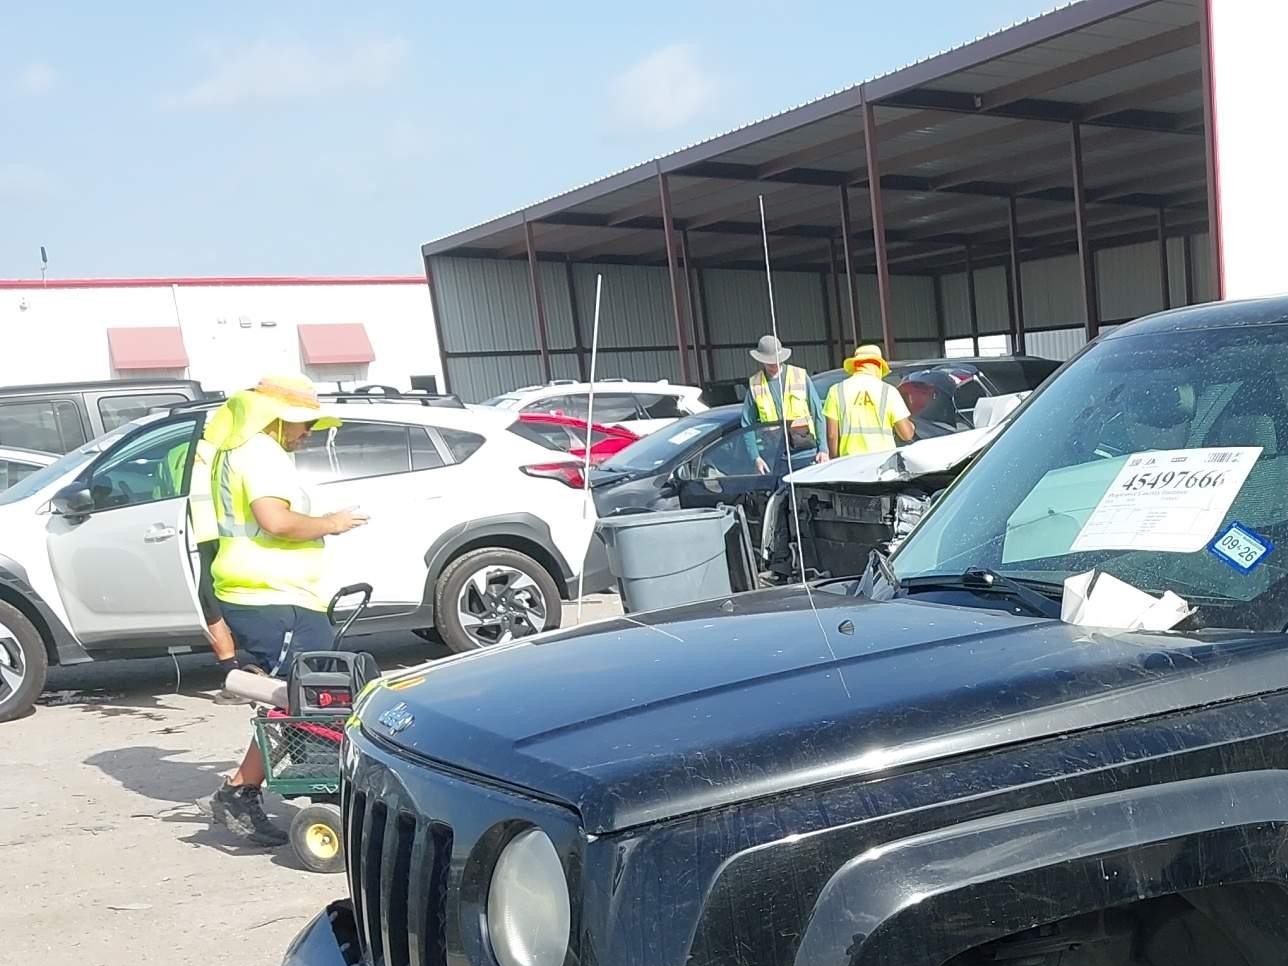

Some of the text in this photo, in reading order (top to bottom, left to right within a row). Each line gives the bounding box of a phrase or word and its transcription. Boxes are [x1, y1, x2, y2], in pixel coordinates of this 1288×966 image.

[1122, 470, 1229, 491] 45497666
[1222, 535, 1240, 550] 09
[1238, 546, 1257, 562] 26
